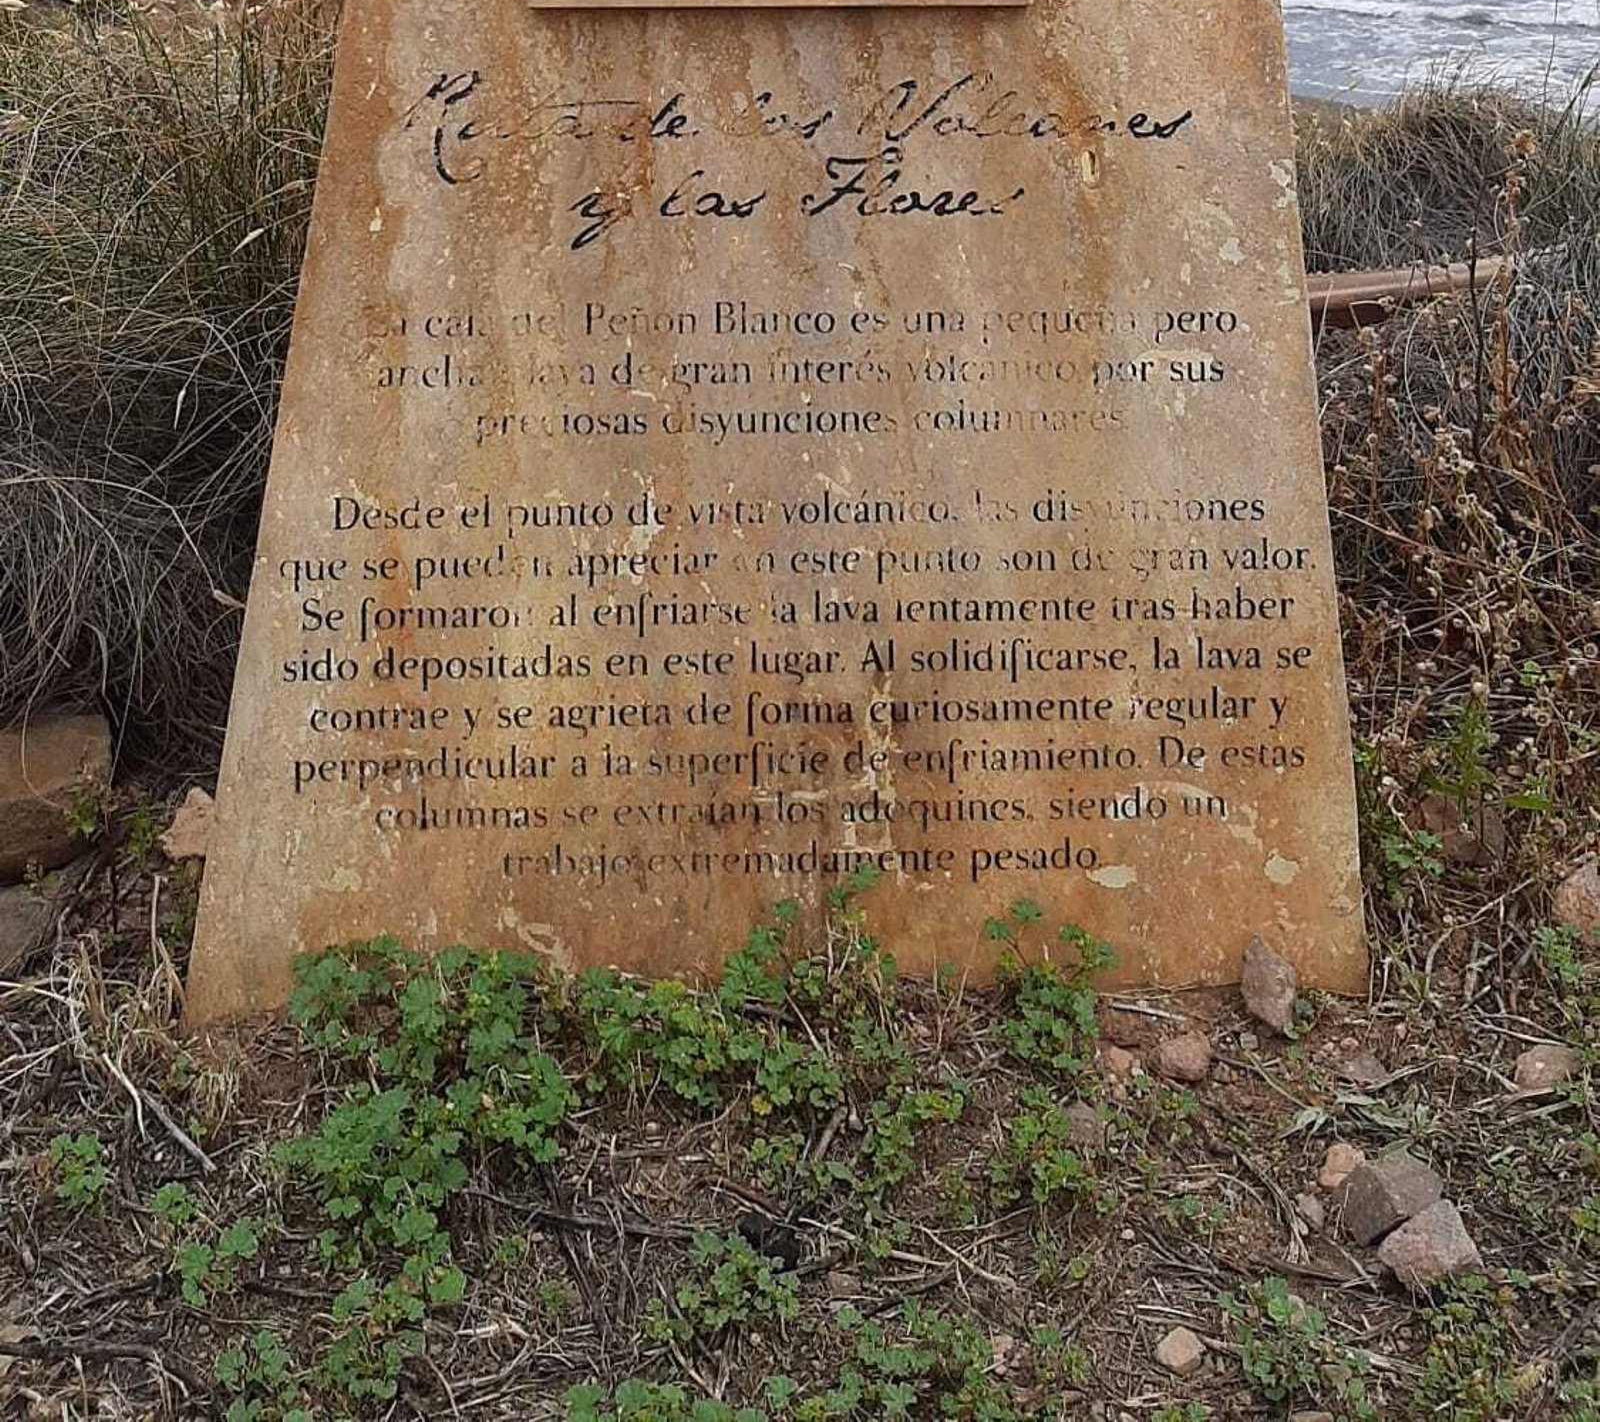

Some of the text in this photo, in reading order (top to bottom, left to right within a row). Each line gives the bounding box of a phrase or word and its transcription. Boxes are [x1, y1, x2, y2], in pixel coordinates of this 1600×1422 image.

[569, 146, 1025, 251] y las Flores
[714, 300, 836, 335] Blanco
[850, 309, 887, 334] es
[903, 308, 965, 333] una
[1154, 307, 1237, 345] pero
[610, 351, 650, 387] de
[669, 359, 751, 397] gran
[768, 348, 890, 385] interés
[1092, 357, 1154, 390] por
[1168, 356, 1225, 384] sus
[660, 401, 898, 447] disyunciones
[332, 494, 446, 531] Desde
[459, 496, 491, 530] el
[507, 499, 614, 539] punto
[626, 491, 672, 527] de
[688, 497, 766, 525] vista
[279, 554, 348, 592] que
[362, 556, 399, 581] se
[413, 543, 554, 591] pueden
[566, 542, 719, 588] apreciar
[731, 549, 775, 575] en
[789, 545, 861, 575] este
[876, 545, 982, 585] punto
[998, 546, 1056, 573] son
[1129, 545, 1209, 582] gran
[1221, 536, 1317, 572] valor.
[300, 597, 345, 632] Se
[549, 592, 577, 627] al
[593, 590, 752, 638] enfriarse
[770, 591, 797, 626] la
[813, 588, 880, 624] lava
[897, 592, 1097, 624] lentamente
[1111, 592, 1176, 621] tras
[1191, 586, 1295, 621] haber
[282, 636, 1313, 692] sido depositadas en este lugar. Al solidificarse, la lava se
[309, 685, 1289, 741] contrae y se agrieta de forma curiosamente regular y
[293, 735, 1307, 795] perpendicular a la superficie de enfriamiento. De estas
[375, 796, 549, 832] columnas
[563, 805, 599, 828] se
[613, 790, 763, 828] extraían
[777, 790, 825, 824] los
[1048, 785, 1168, 821] siendo
[1181, 792, 1229, 820] un
[502, 835, 1103, 883] trabajo extremadamente pesado.
